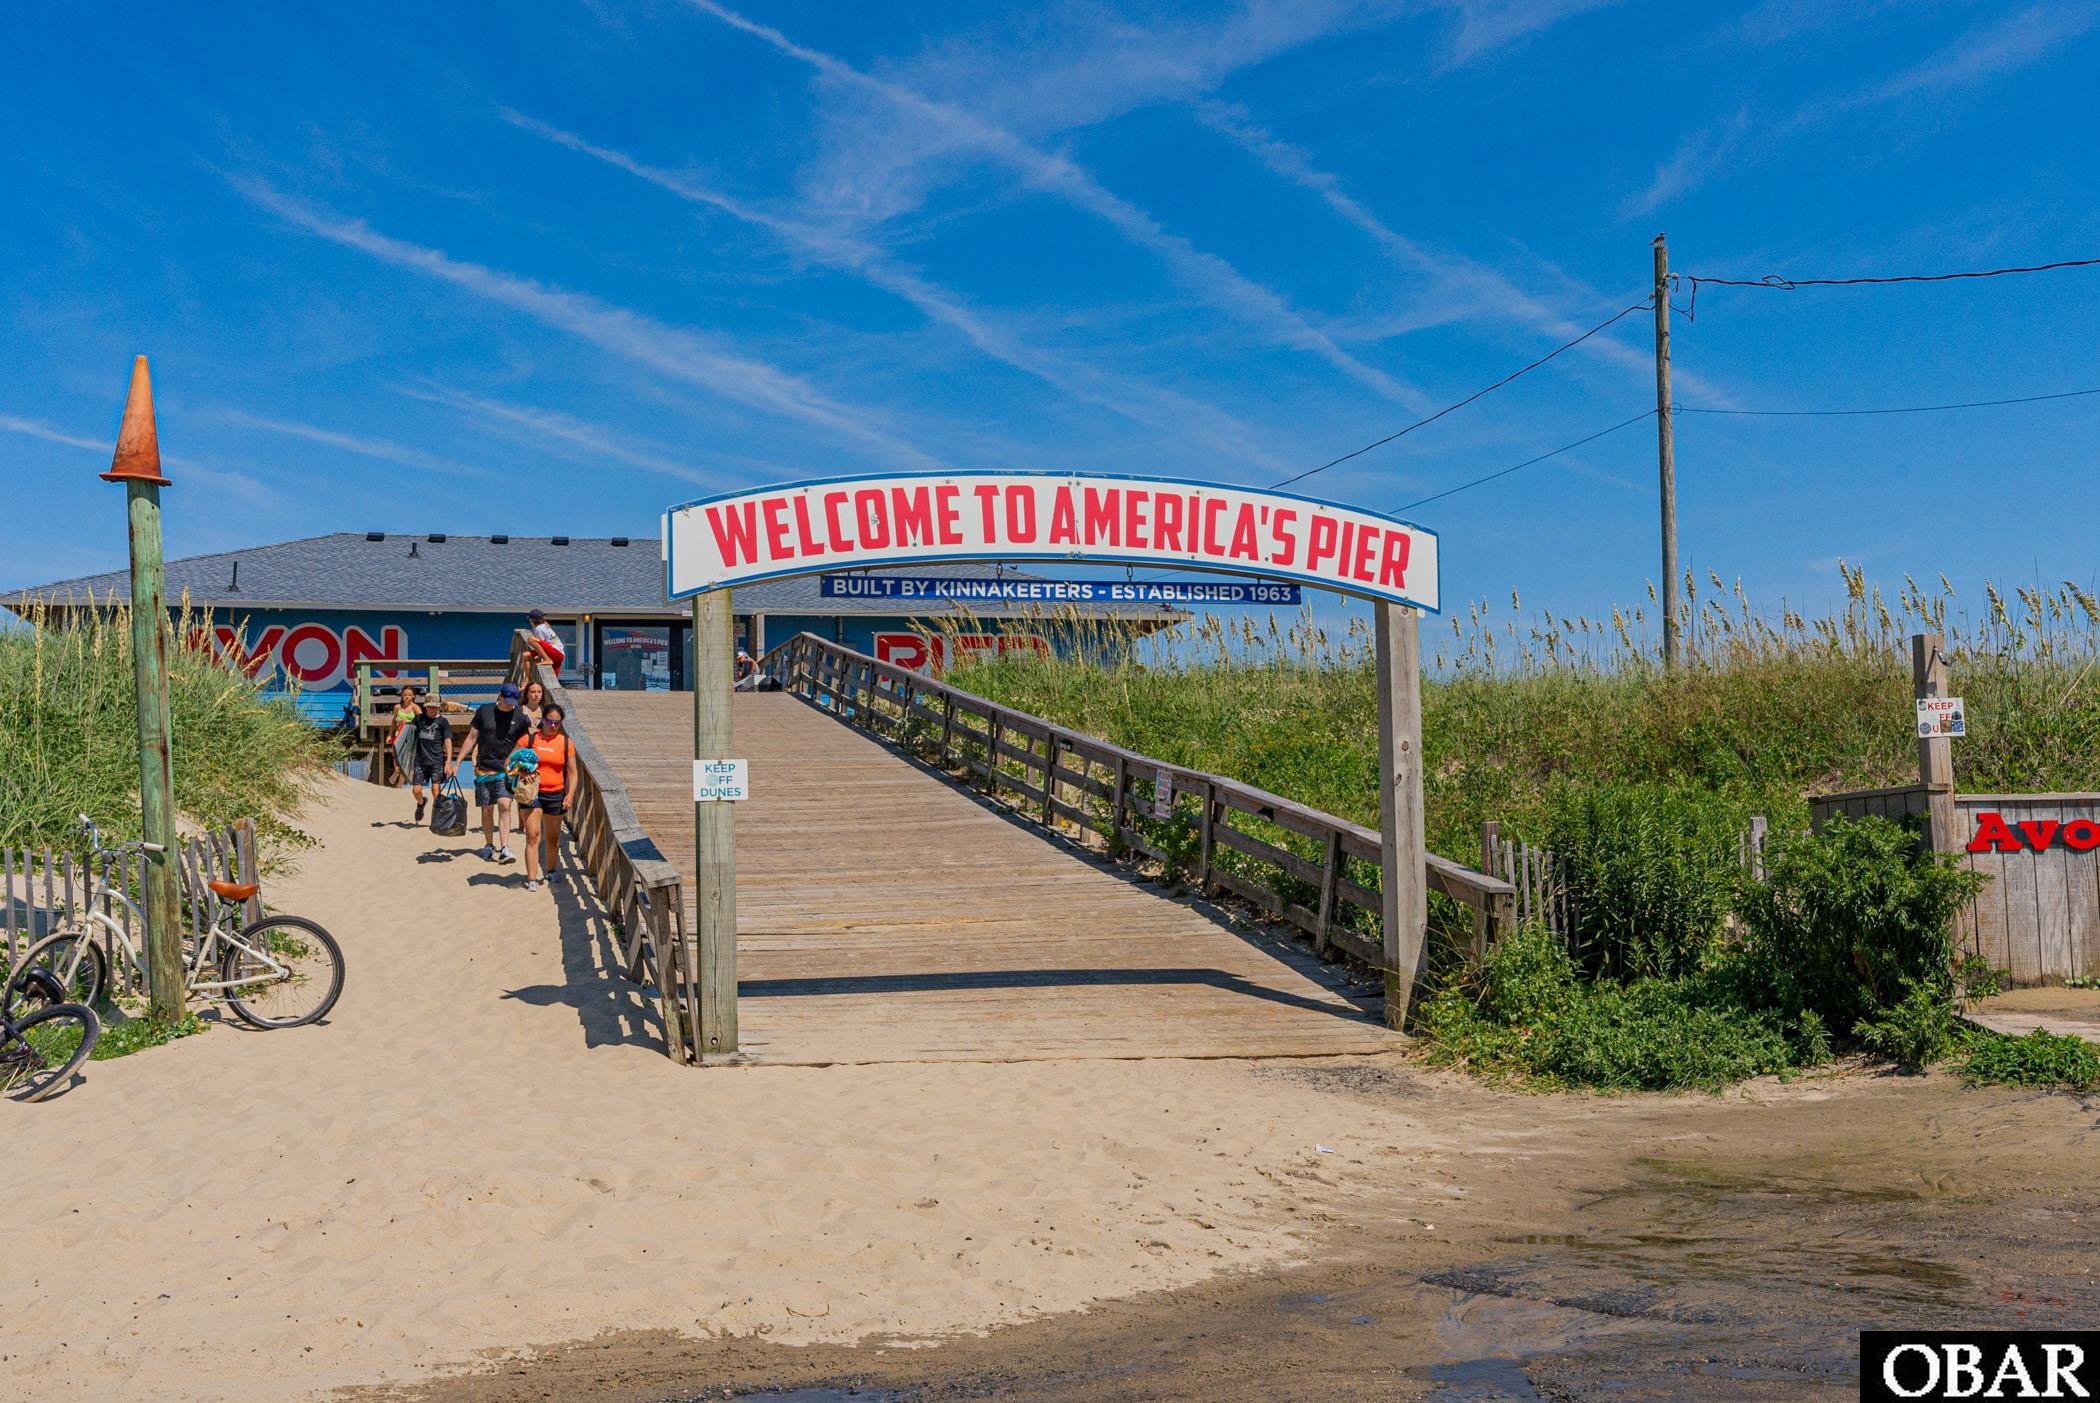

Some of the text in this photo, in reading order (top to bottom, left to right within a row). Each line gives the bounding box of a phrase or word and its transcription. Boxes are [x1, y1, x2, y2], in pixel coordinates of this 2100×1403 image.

[705, 484, 1411, 589] WELCOME TO AMERICA'S PIER
[833, 579, 895, 595] BUILT
[901, 580, 930, 596] BY
[935, 581, 1093, 599] KINNAKEETERS
[1111, 584, 1244, 601] ESTABLISHED
[1249, 586, 1292, 602] 1963
[187, 625, 400, 683] VON
[1927, 701, 1954, 710] KEEP
[705, 763, 736, 773] KEEP
[700, 787, 741, 797] DUNES
[1966, 812, 2100, 852] Avo
